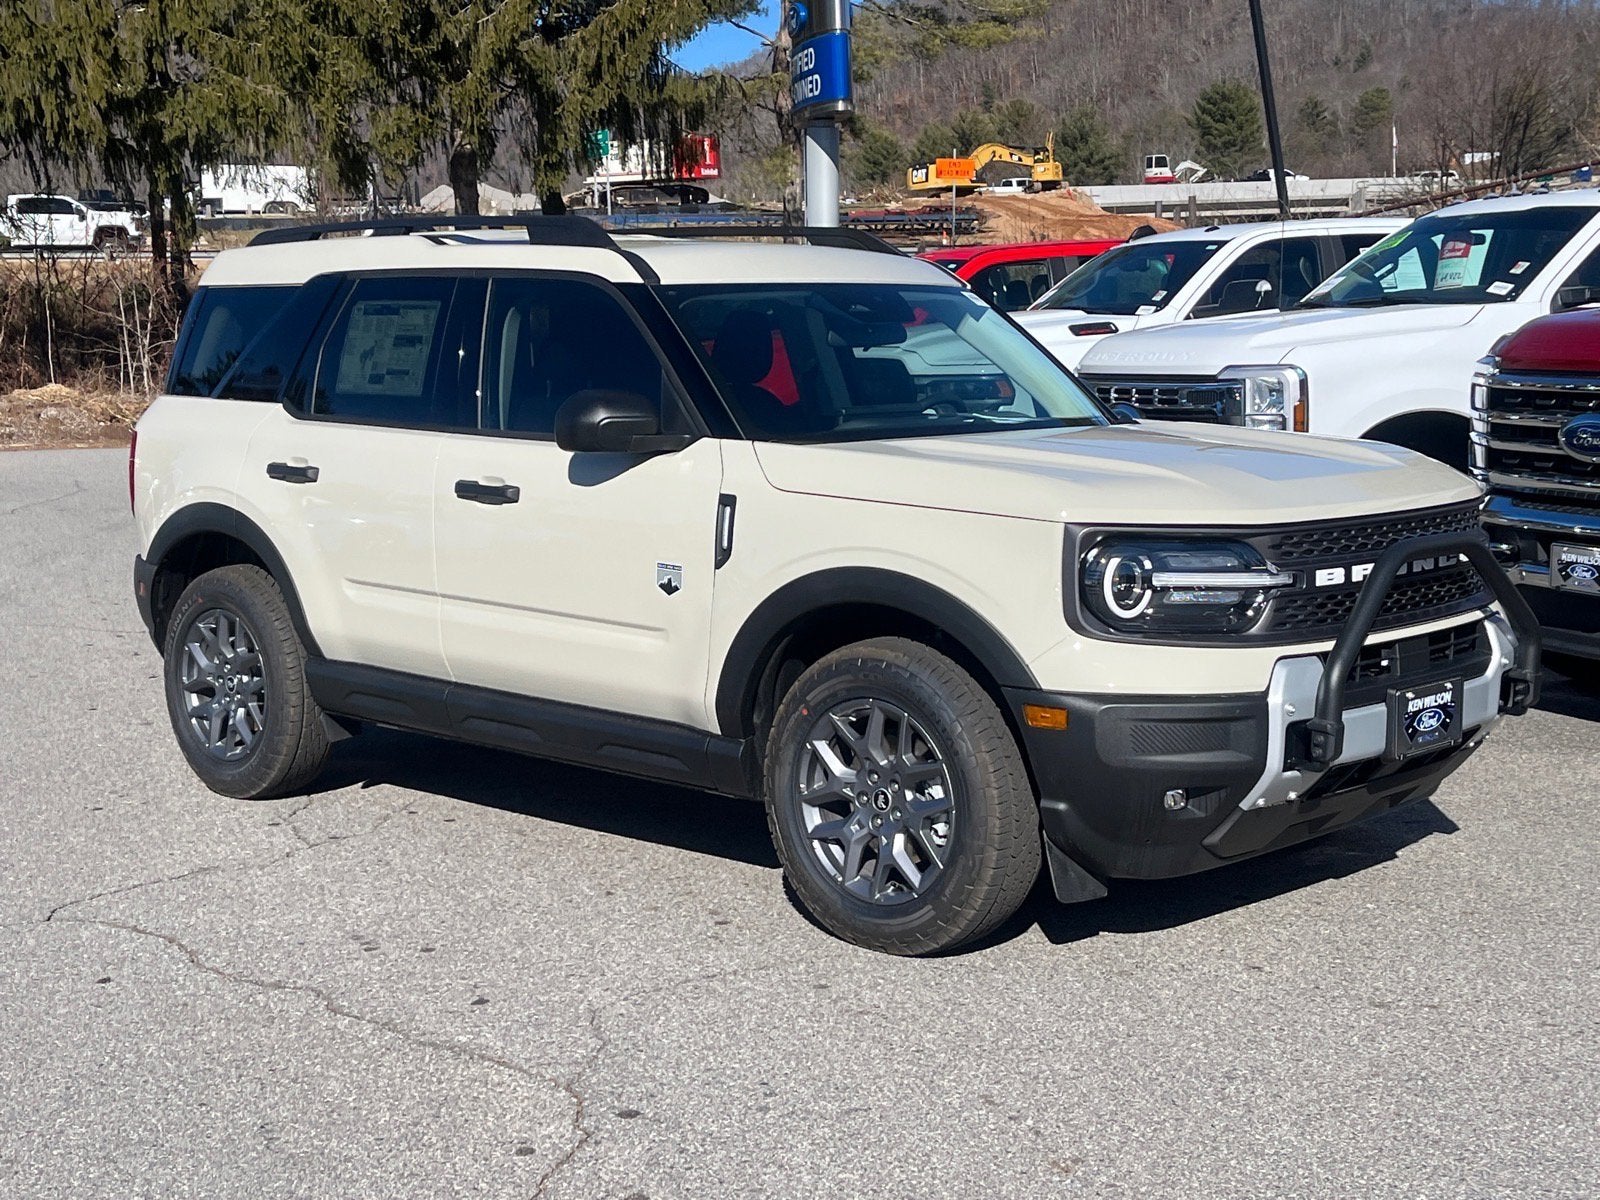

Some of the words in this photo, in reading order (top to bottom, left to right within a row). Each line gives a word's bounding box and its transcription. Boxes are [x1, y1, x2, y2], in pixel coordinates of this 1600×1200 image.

[913, 169, 927, 183] CAT
[1561, 552, 1577, 563] KEN
[1577, 554, 1600, 567] WILSO
[1315, 553, 1469, 587] BRNC
[1573, 564, 1592, 578] Ford
[1407, 697, 1423, 713] KEN
[1423, 690, 1453, 709] WILSON
[1419, 711, 1438, 729] Ford
